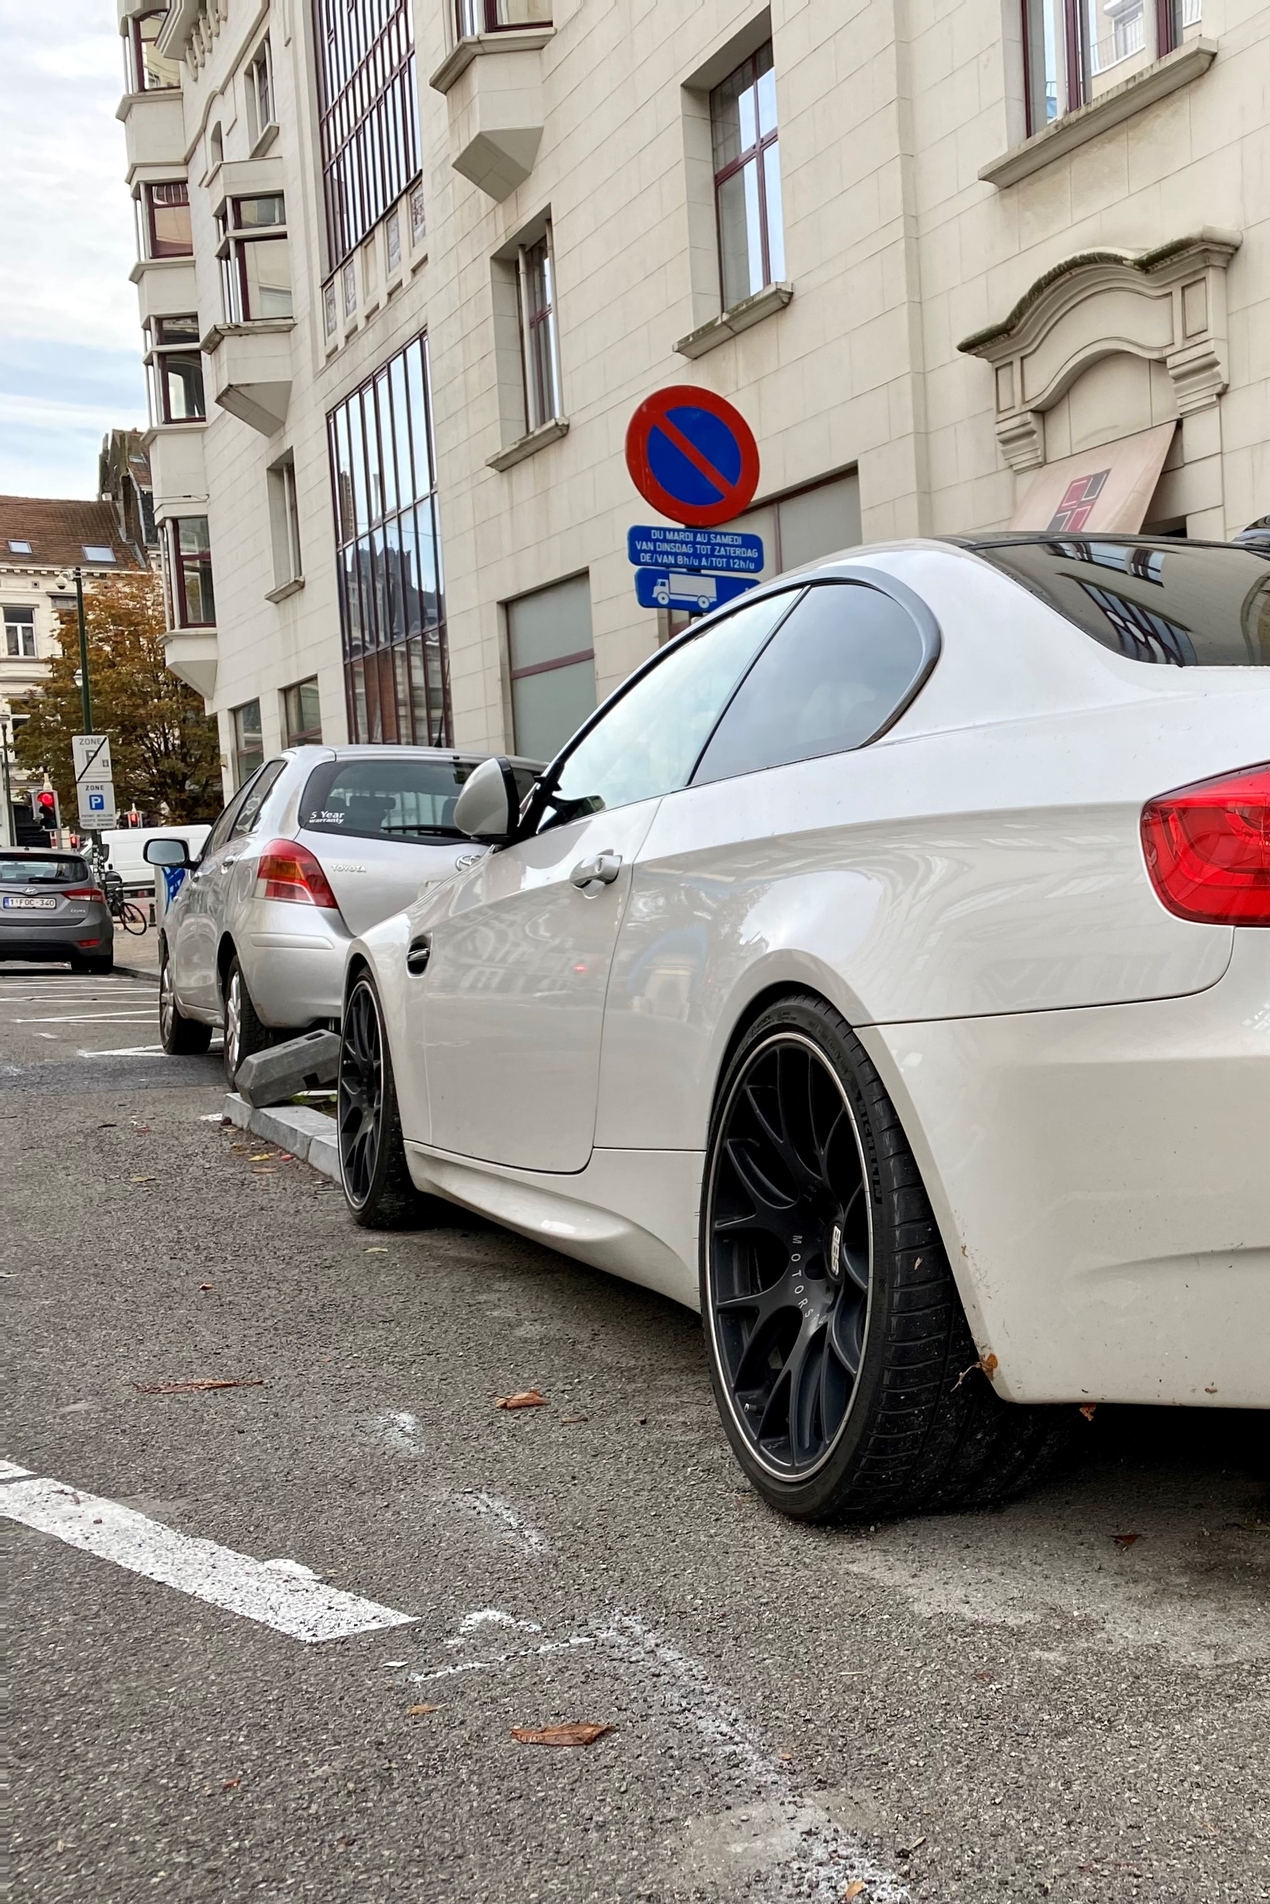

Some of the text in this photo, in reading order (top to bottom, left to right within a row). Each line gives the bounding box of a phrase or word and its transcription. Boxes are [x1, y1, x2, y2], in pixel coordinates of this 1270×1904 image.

[651, 530, 742, 545] DU MARDI AU SAMEDI
[635, 541, 758, 558] VAN DINSDAG TOT ZATERDAG
[640, 553, 755, 569] DE/VAN 8h/u A/TOT 12h/u
[79, 738, 102, 746] ZONE
[90, 796, 101, 809] P
[310, 810, 345, 819] 5 Year
[331, 864, 367, 873] TOYOTA
[830, 1224, 841, 1277] BBS
